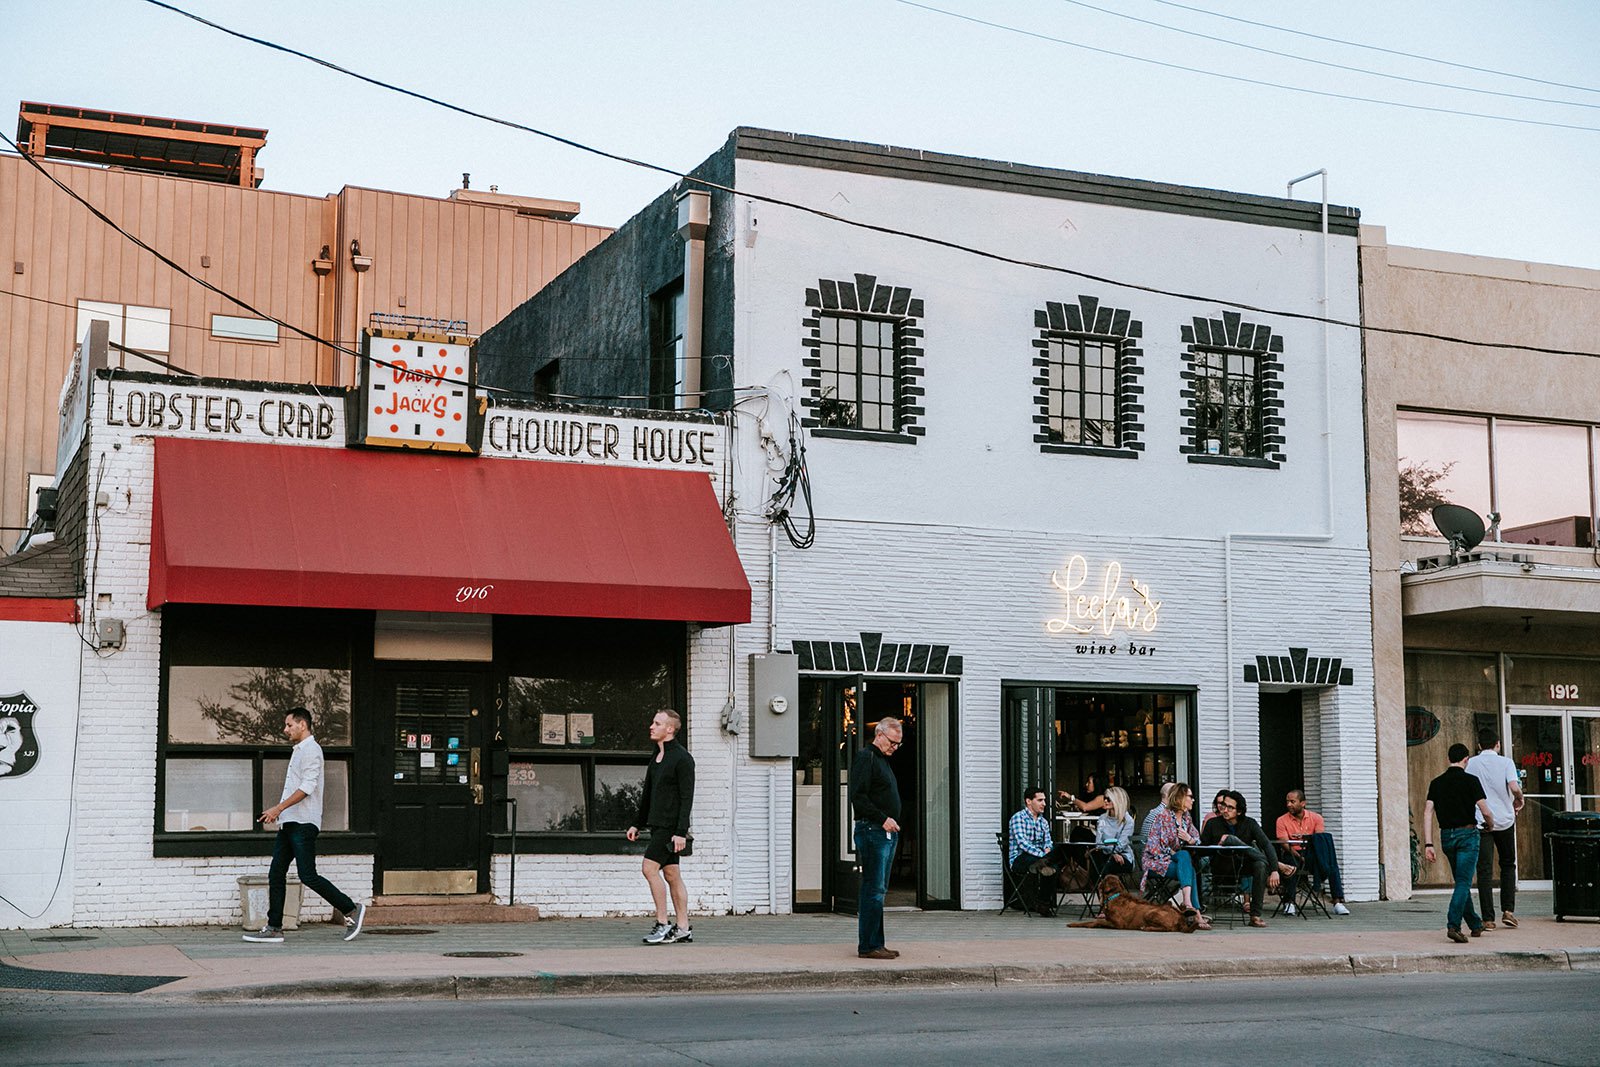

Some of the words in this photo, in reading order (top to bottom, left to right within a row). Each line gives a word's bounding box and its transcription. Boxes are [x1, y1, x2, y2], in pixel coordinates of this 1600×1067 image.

[107, 388, 334, 440] LOBSTER-CRAB
[386, 392, 447, 418] JACK'S
[489, 416, 619, 460] CHOWDER
[633, 426, 714, 466] HOUSE
[455, 584, 494, 603] 1916
[1047, 555, 1161, 635] Leela's
[1075, 641, 1116, 654] wine
[1129, 642, 1156, 656] bar
[1550, 684, 1579, 699] 1912
